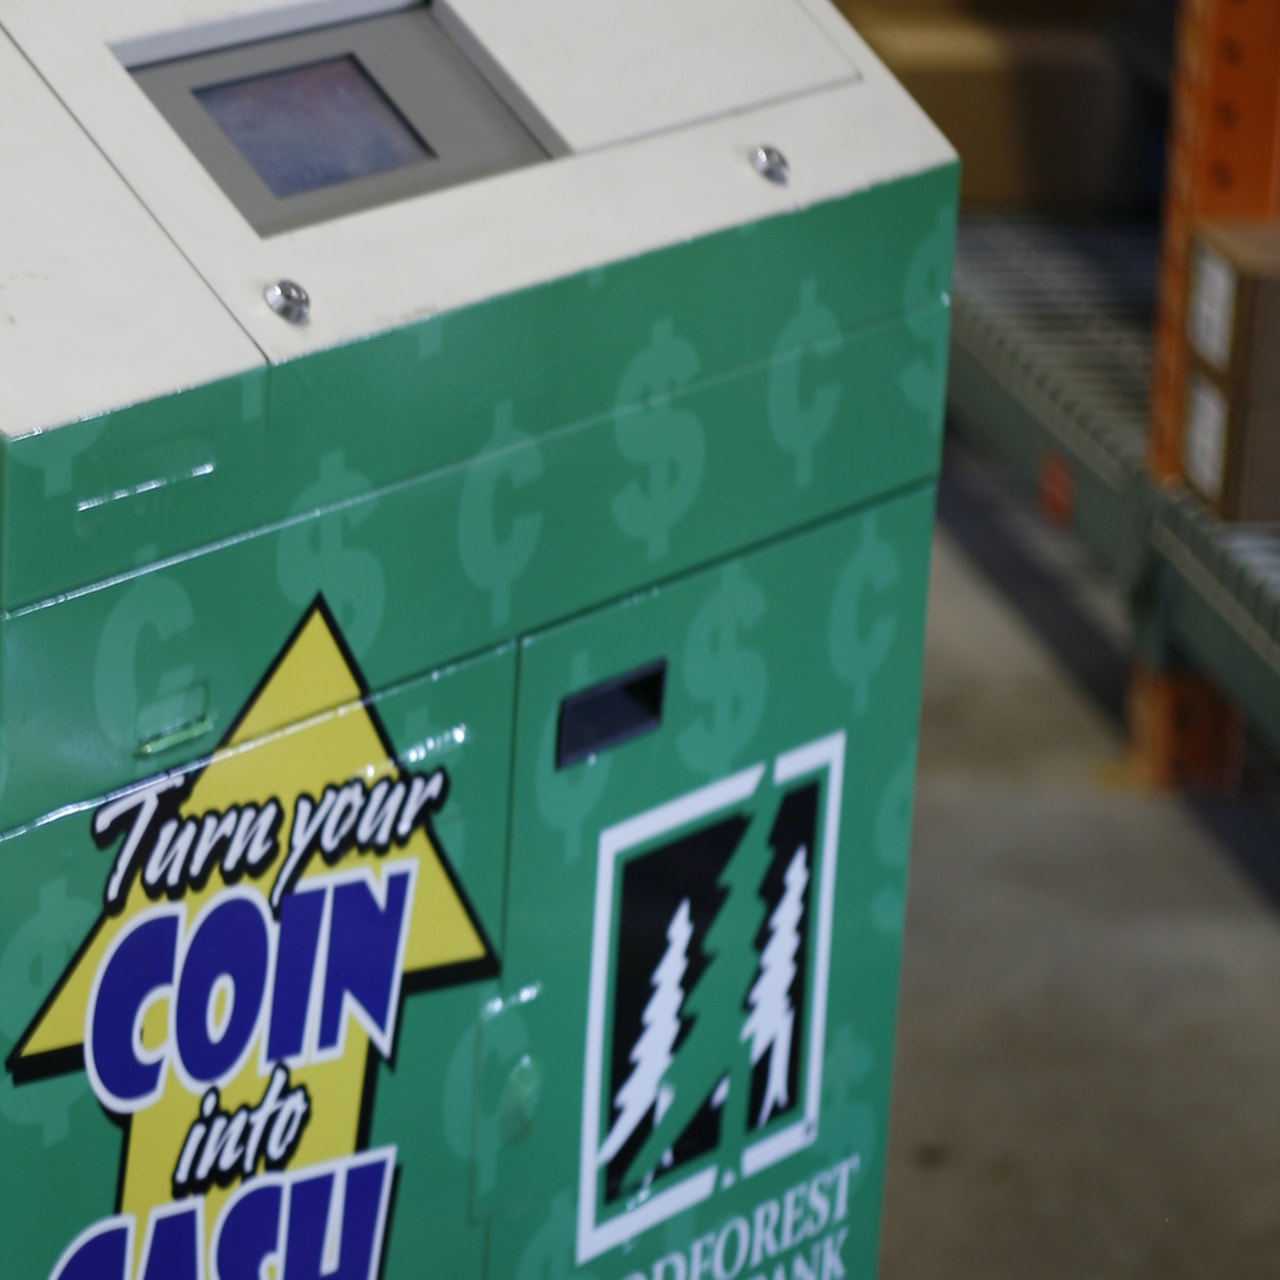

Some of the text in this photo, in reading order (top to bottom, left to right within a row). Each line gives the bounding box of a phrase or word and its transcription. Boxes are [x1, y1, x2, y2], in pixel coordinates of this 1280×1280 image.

[95, 771, 443, 905] Turn your
[85, 858, 419, 1114] COIN
[175, 1069, 308, 1183] into
